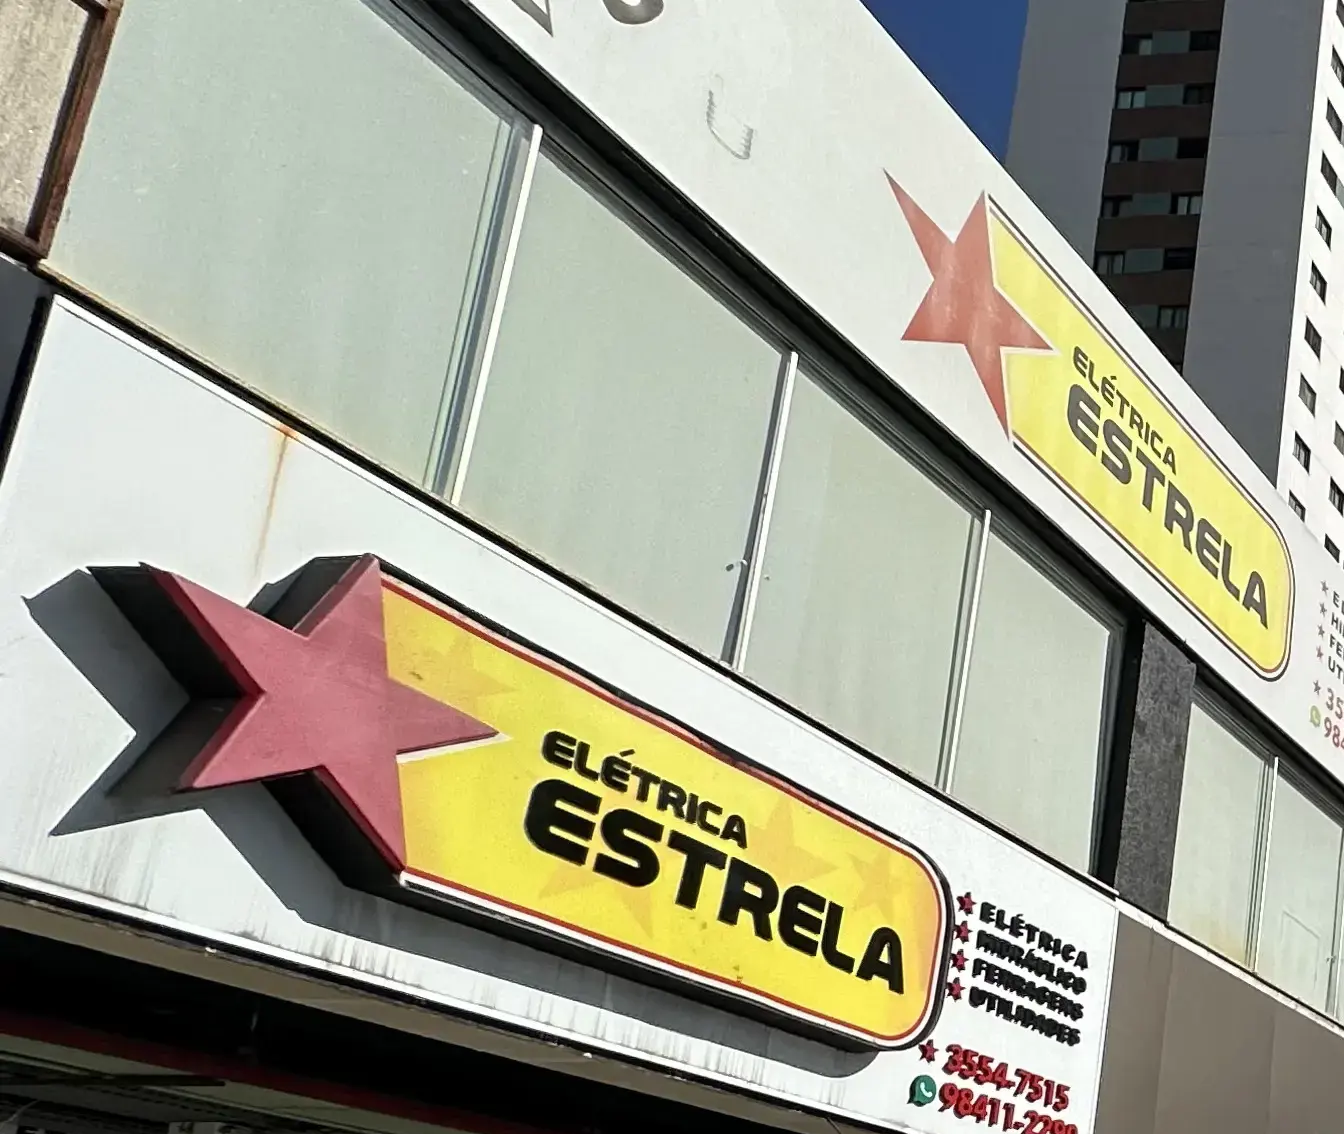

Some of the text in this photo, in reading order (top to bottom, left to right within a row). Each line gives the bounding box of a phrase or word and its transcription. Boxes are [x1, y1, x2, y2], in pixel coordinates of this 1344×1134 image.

[1073, 346, 1177, 476] ELÉTRICA
[1067, 384, 1269, 630] ESTRELA
[542, 730, 748, 849] ELÉTRICA
[523, 778, 905, 995] ESTRELA
[976, 929, 1088, 995] HIDRÁULICO
[979, 901, 1089, 970] ELÉTRICA
[969, 986, 1081, 1047] UTILIDADES
[972, 957, 1084, 1022] FERRAGENS
[942, 1044, 1071, 1112] 3554-7515
